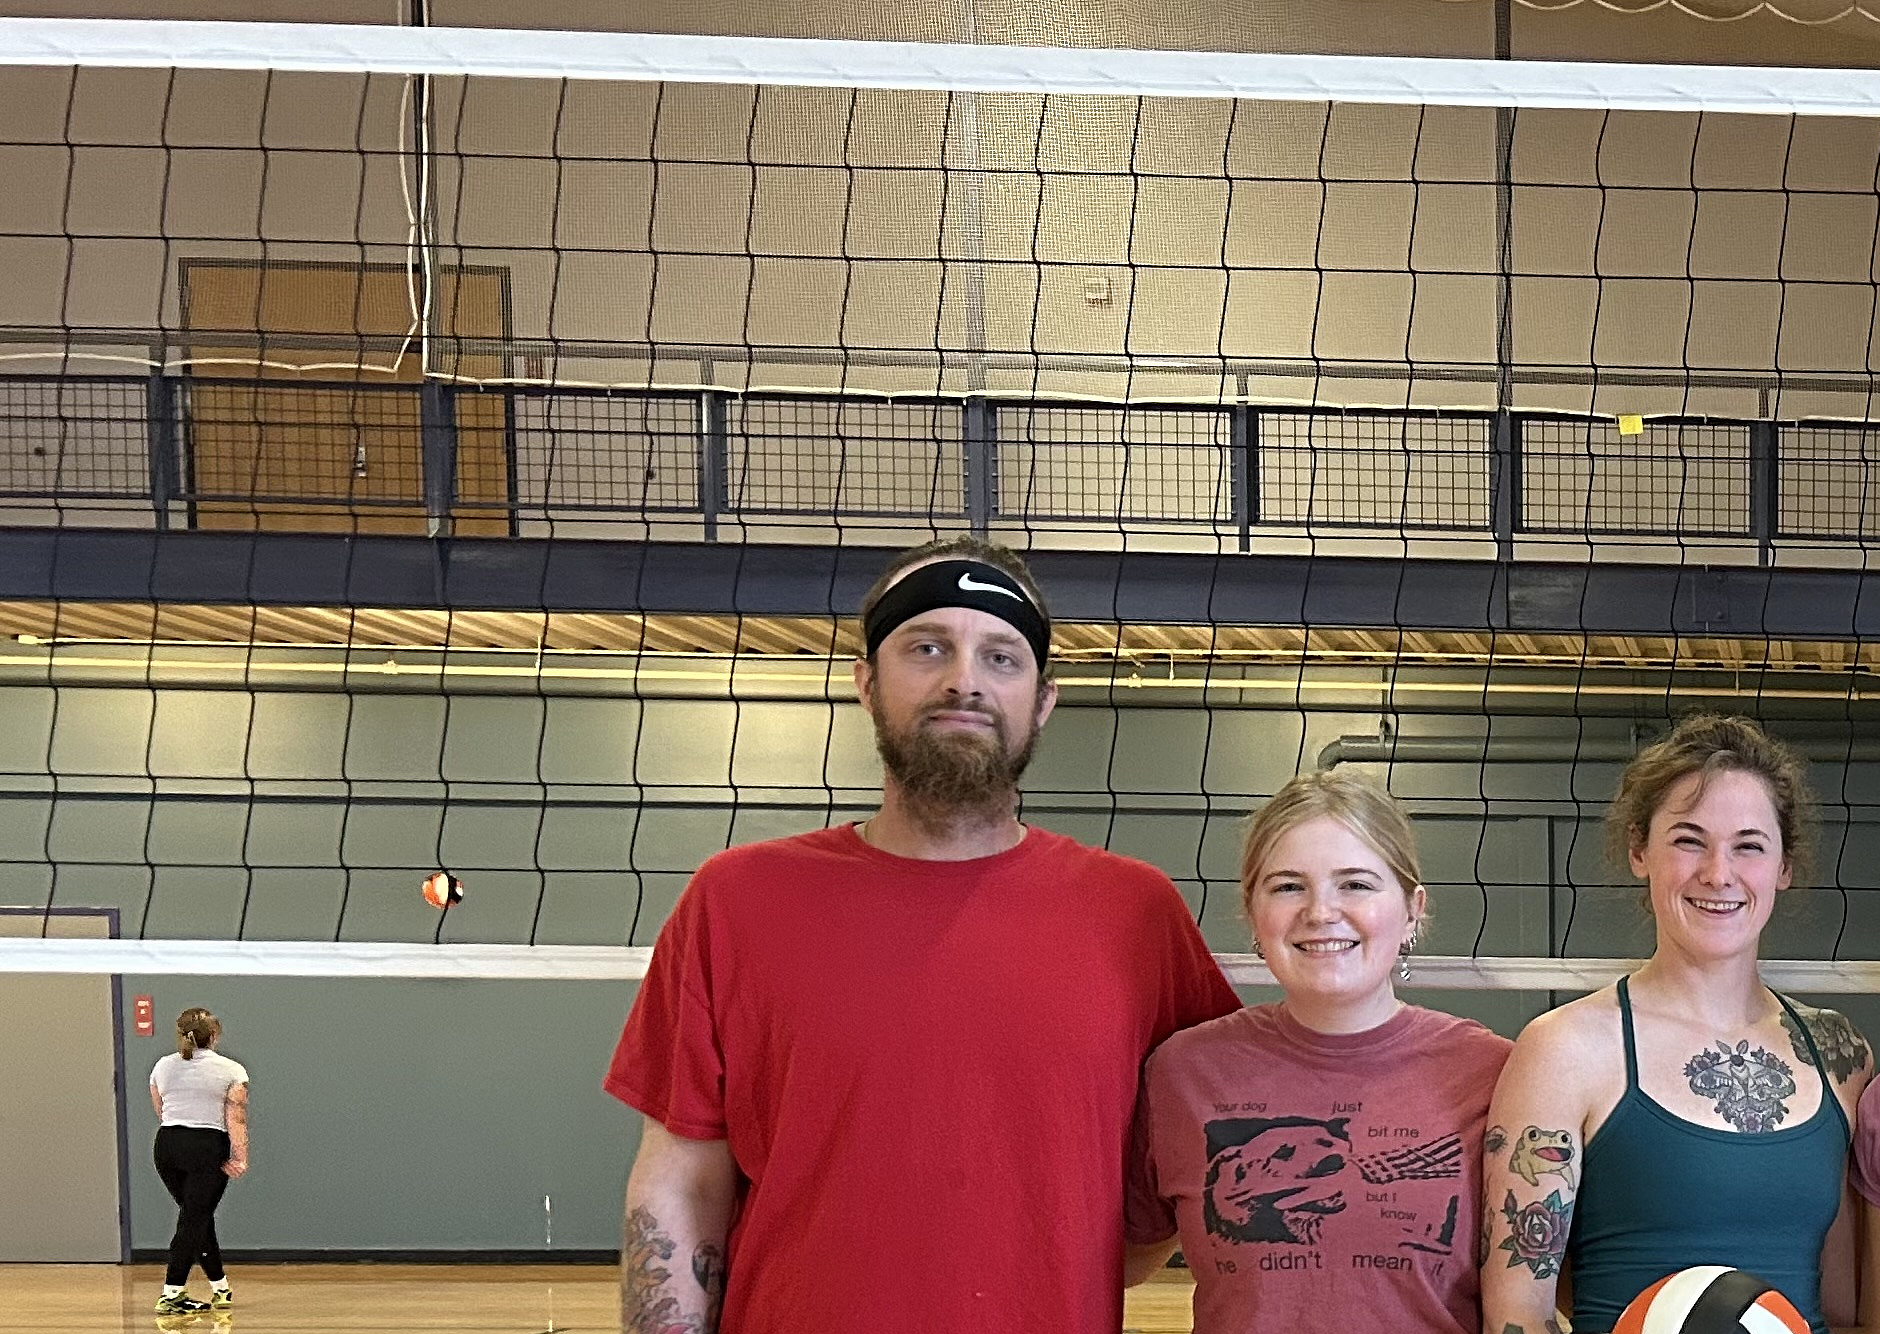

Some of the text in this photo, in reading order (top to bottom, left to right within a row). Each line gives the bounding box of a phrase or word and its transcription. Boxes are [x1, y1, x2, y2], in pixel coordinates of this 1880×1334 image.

[1242, 1101, 1267, 1113] dog
[1332, 1101, 1363, 1114] just
[1367, 1126, 1420, 1139] bit me
[1366, 1191, 1388, 1202] but
[1380, 1207, 1418, 1222] know
[1214, 1250, 1445, 1276] he didn't mean it
